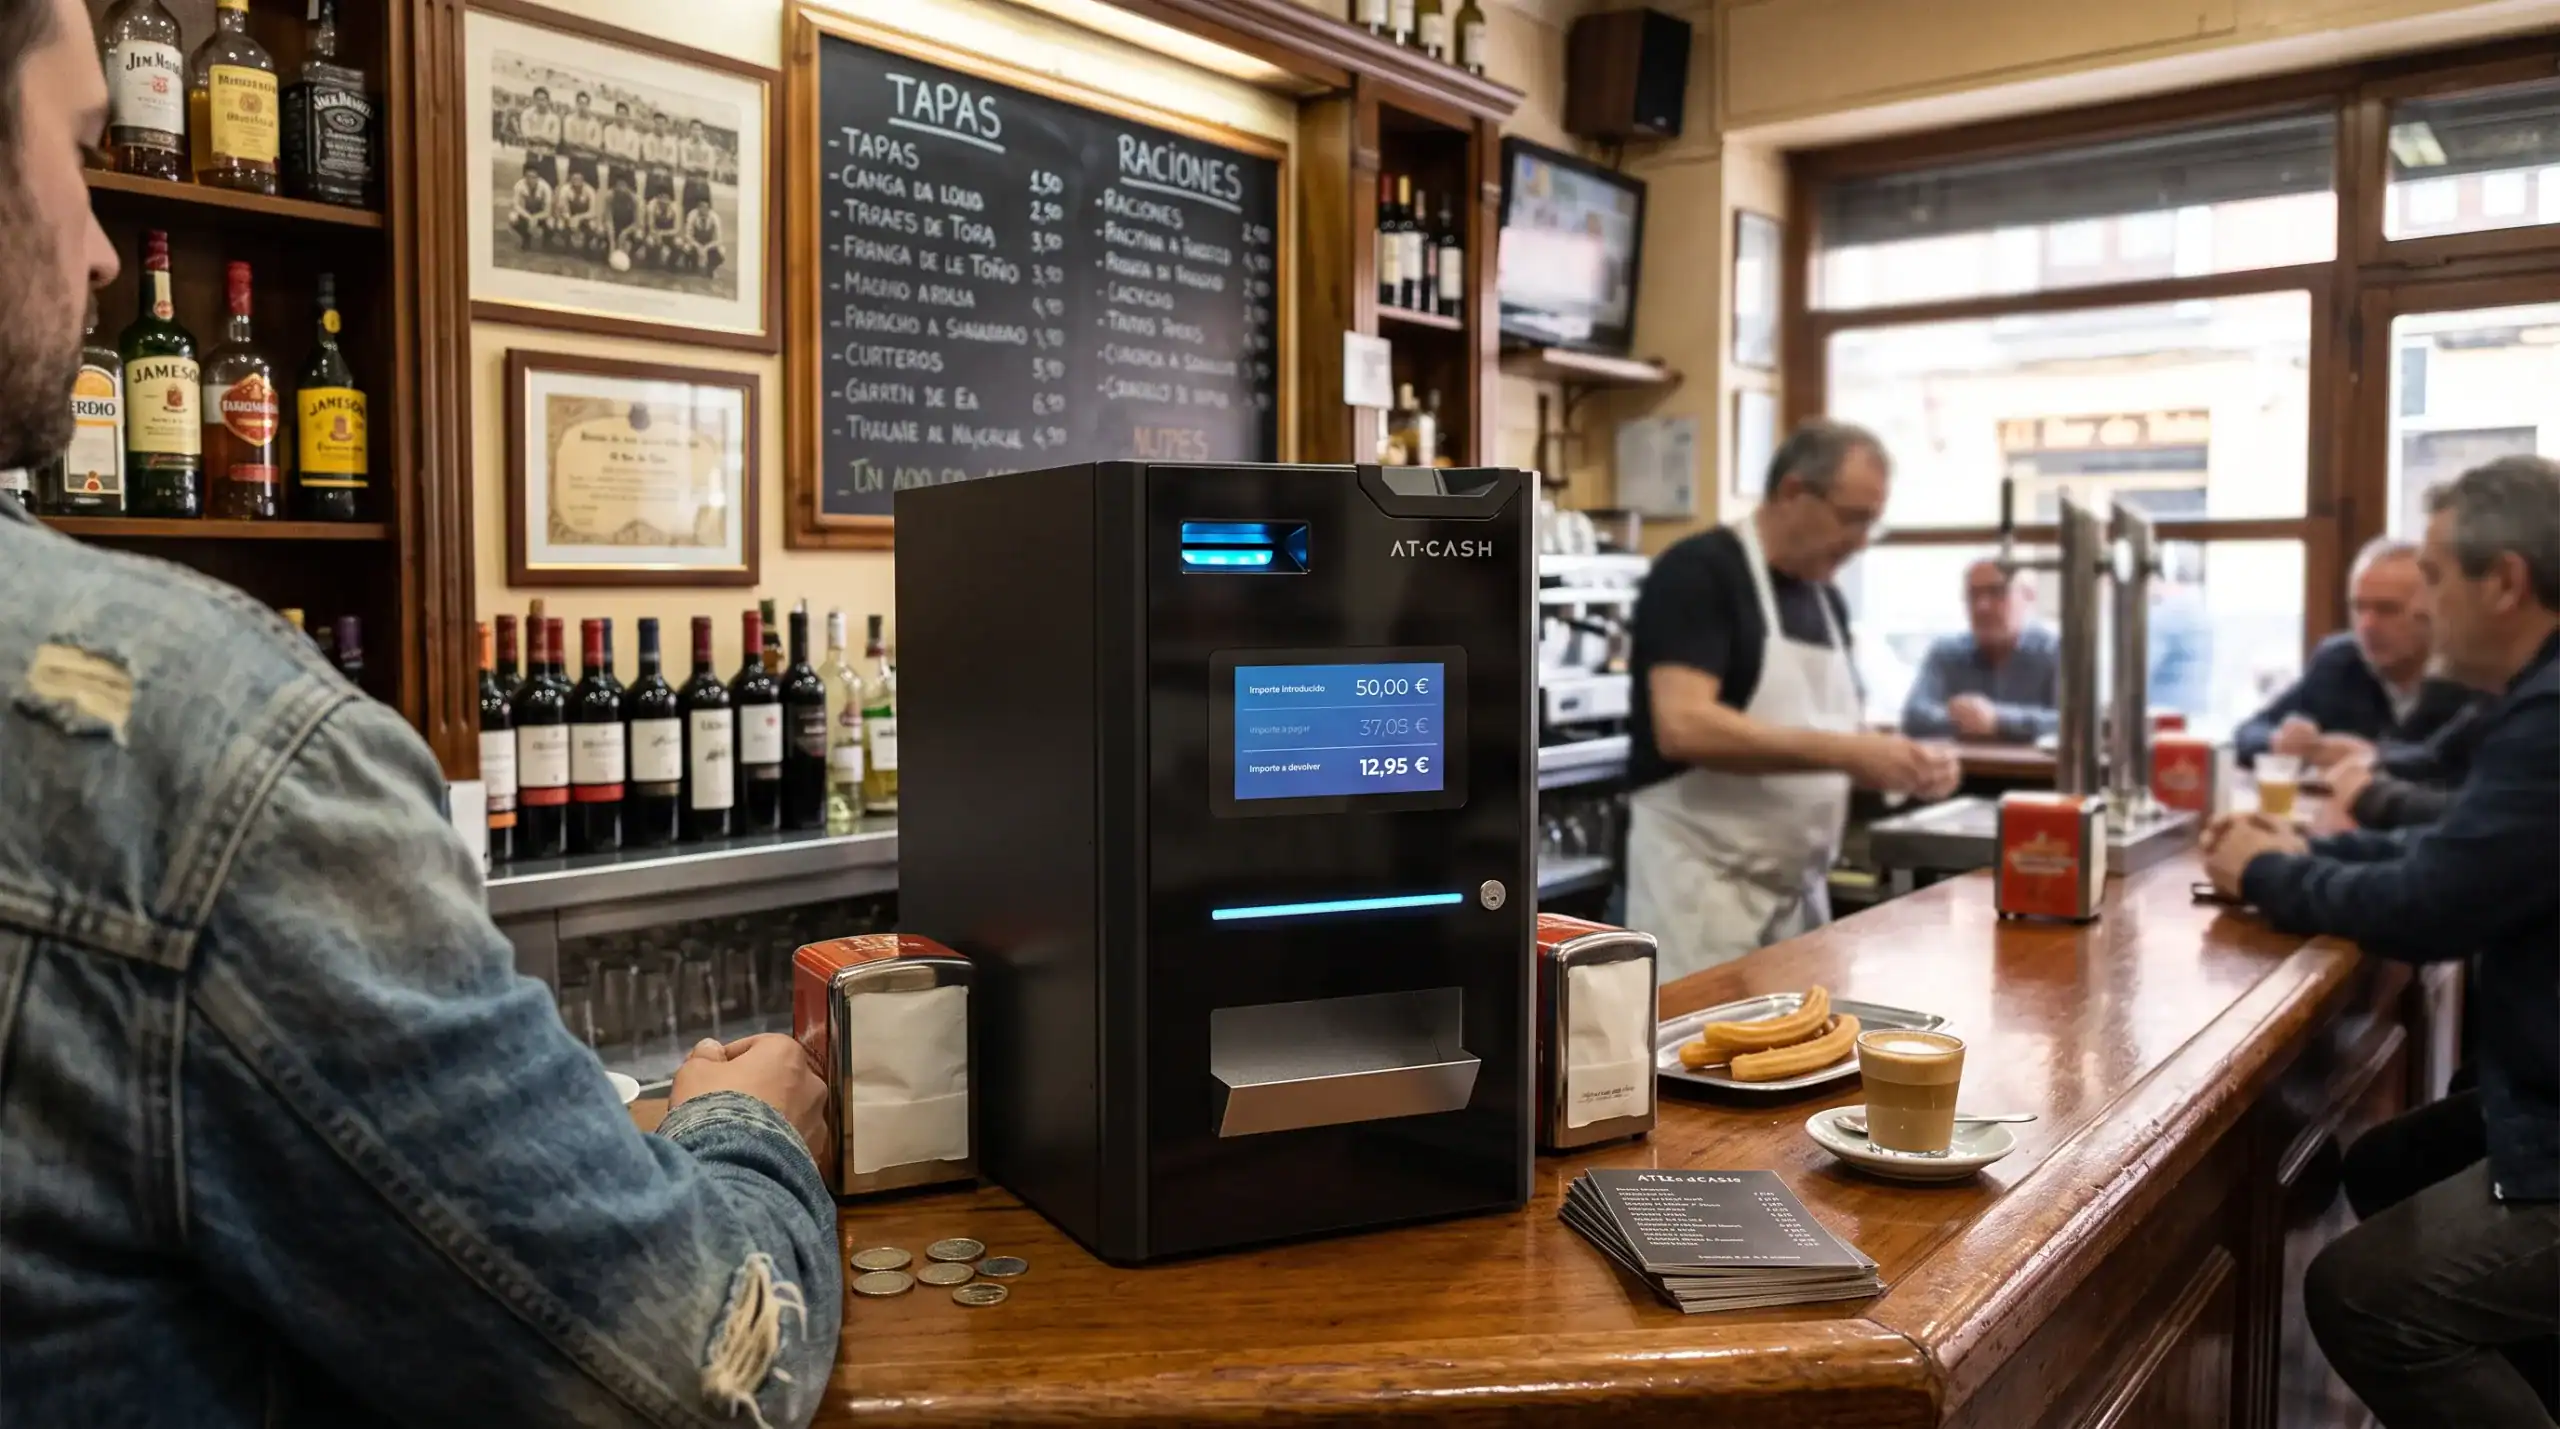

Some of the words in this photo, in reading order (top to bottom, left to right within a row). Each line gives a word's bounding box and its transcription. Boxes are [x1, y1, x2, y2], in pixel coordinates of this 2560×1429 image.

[885, 72, 1002, 139] TAPAS
[841, 126, 920, 170] TAPAS
[1249, 685, 1280, 696] Importe
[1356, 679, 1409, 697] 50,00
[1415, 677, 1429, 695] €
[1415, 717, 1429, 734] €
[1249, 764, 1280, 774] Importe
[1288, 762, 1321, 771] devolver
[1359, 757, 1408, 778] 12,95
[1414, 756, 1429, 774] €
